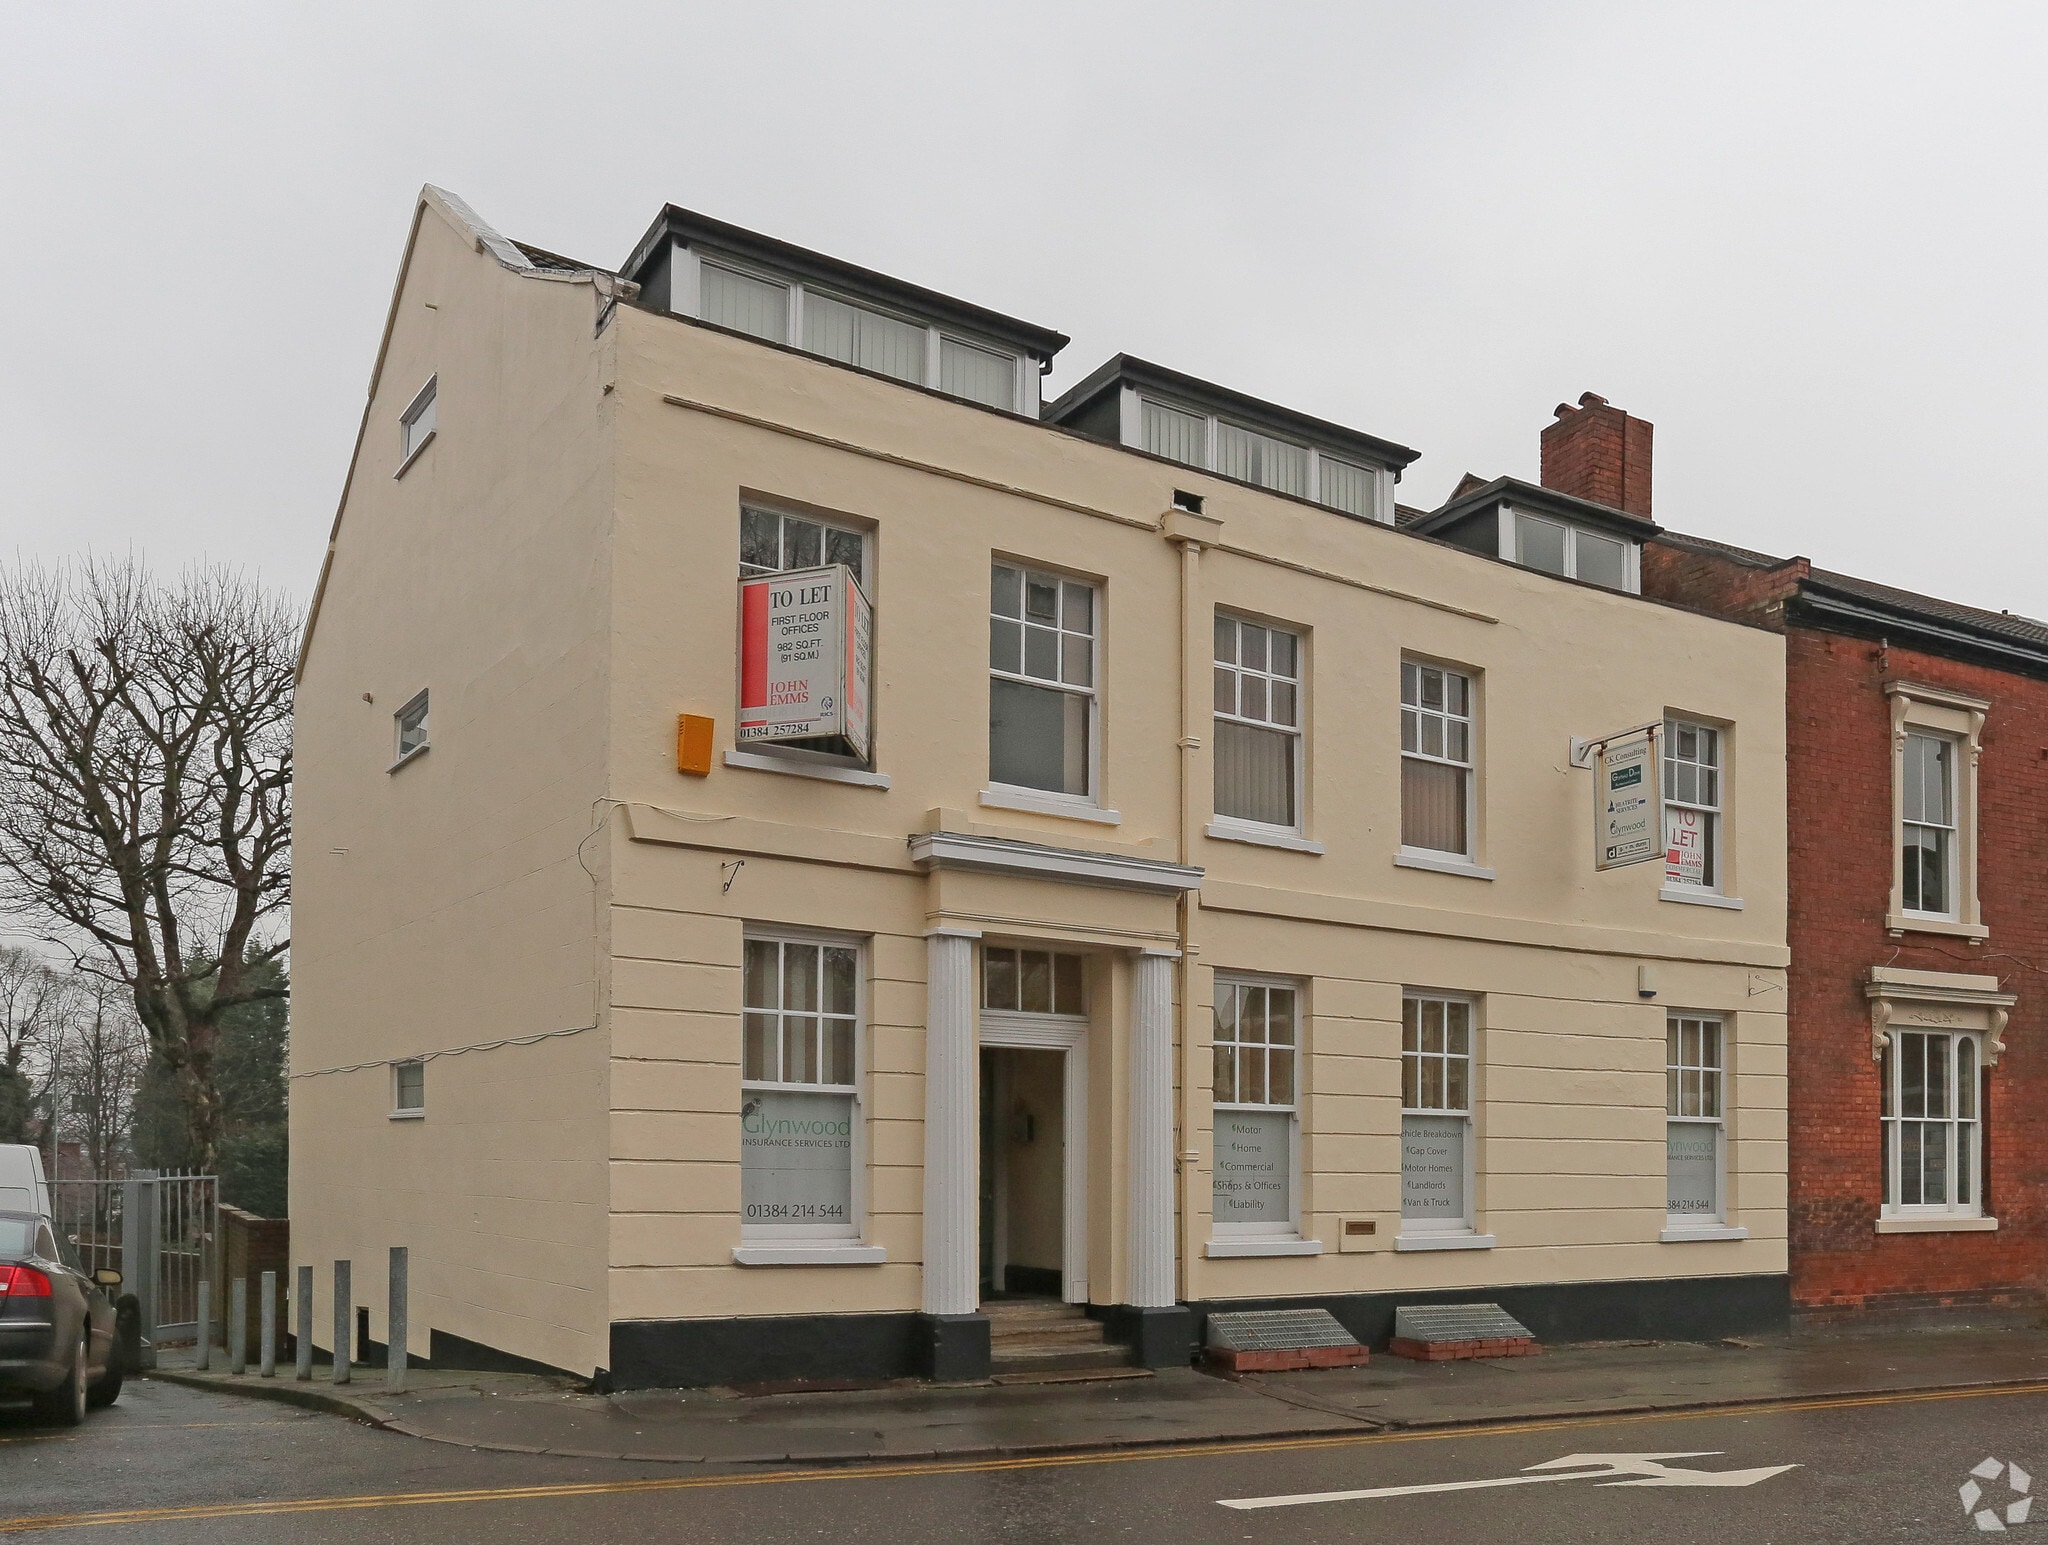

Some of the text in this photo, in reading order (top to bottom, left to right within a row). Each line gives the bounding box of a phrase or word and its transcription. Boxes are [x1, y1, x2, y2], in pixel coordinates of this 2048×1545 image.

[770, 585, 831, 609] TO LET
[771, 611, 830, 626] FIRST FLOOR
[781, 623, 819, 636] OFFICES
[777, 642, 793, 652] 982
[780, 654, 792, 664] (91
[770, 680, 809, 695] JOHN
[770, 692, 809, 706] EMMS
[740, 723, 810, 738] 01384 257284
[1604, 755, 1614, 765] CK
[1615, 747, 1647, 761] Consulting
[1677, 809, 1696, 826] TO
[1610, 819, 1646, 835] Glynwood
[1672, 828, 1698, 848] LET
[1681, 850, 1702, 860] JOHN
[1681, 859, 1702, 868] EMMS
[742, 1113, 851, 1139] Glynwood
[1236, 1125, 1262, 1134] Motor
[1423, 1129, 1463, 1138] Breakdown
[742, 1139, 851, 1148] INSURANCE SERVICES LTD
[1236, 1143, 1262, 1152] Home
[1410, 1147, 1447, 1157] Gap Cover
[1224, 1162, 1274, 1171] Commercial
[1404, 1164, 1453, 1173] Motor Homes
[1217, 1181, 1281, 1191] Shops & Offices
[1411, 1181, 1446, 1190] Landlords
[1233, 1199, 1265, 1210] Liability
[1407, 1198, 1450, 1207] Van & Truck
[1682, 1199, 1695, 1209] 214
[1695, 1199, 1709, 1209] 544
[747, 1204, 844, 1218] 01384 214 544
